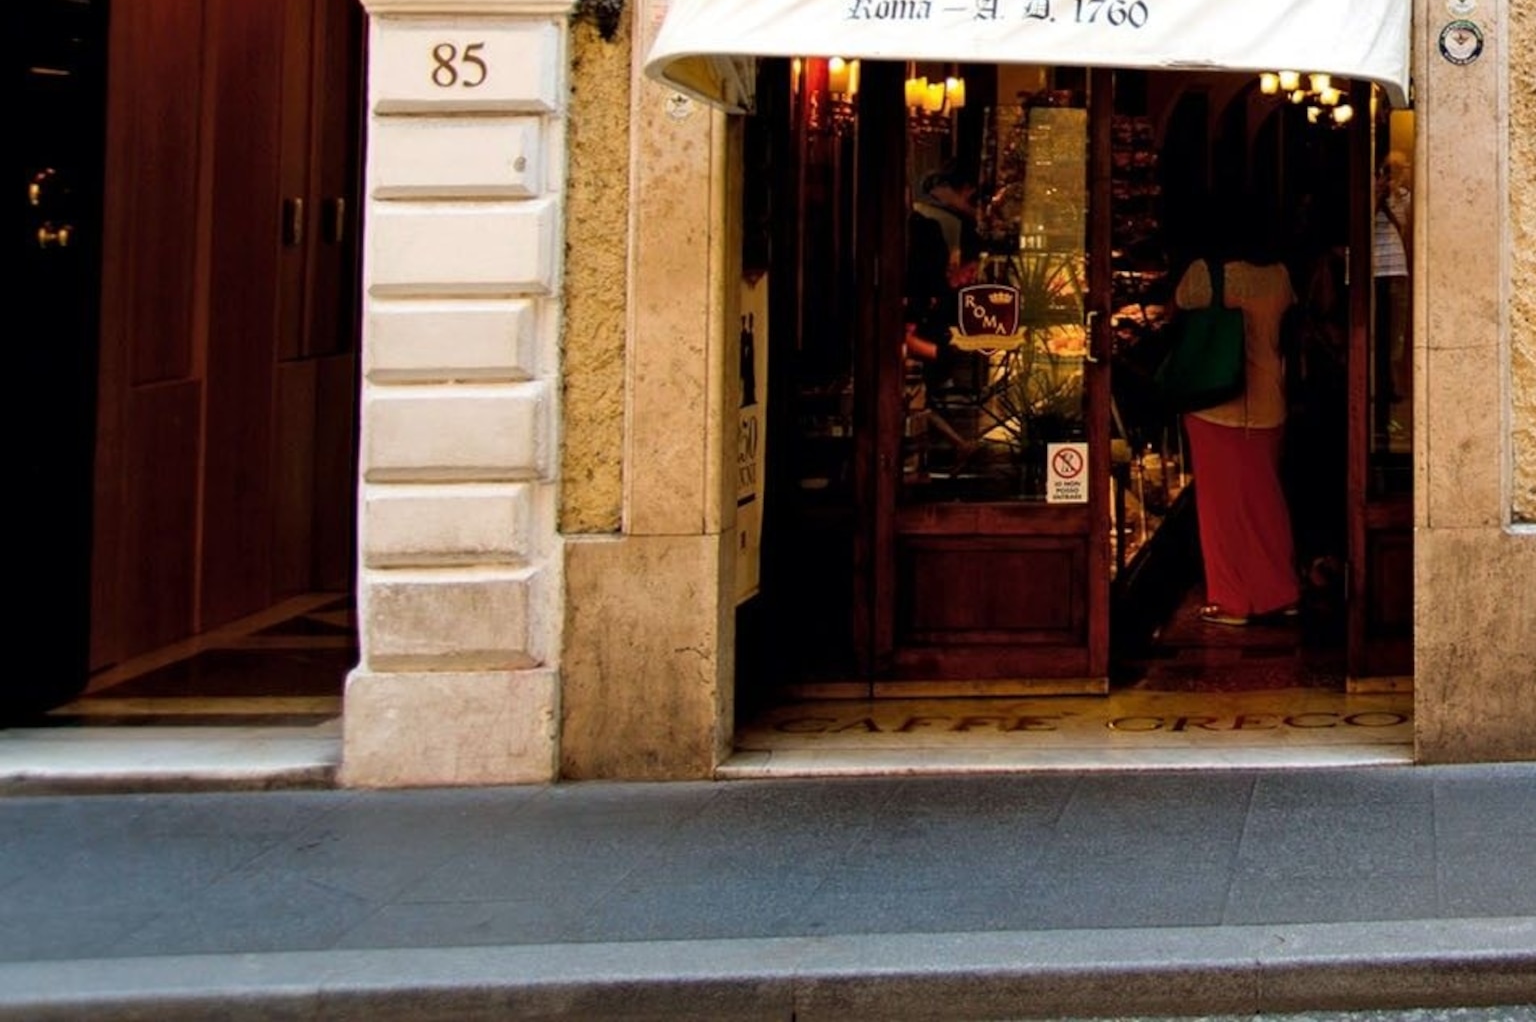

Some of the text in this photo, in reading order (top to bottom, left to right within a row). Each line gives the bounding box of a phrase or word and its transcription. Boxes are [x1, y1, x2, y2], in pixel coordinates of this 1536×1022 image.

[431, 42, 488, 88] 85
[964, 295, 1007, 335] ROMA
[1106, 711, 1408, 732] GRECO
